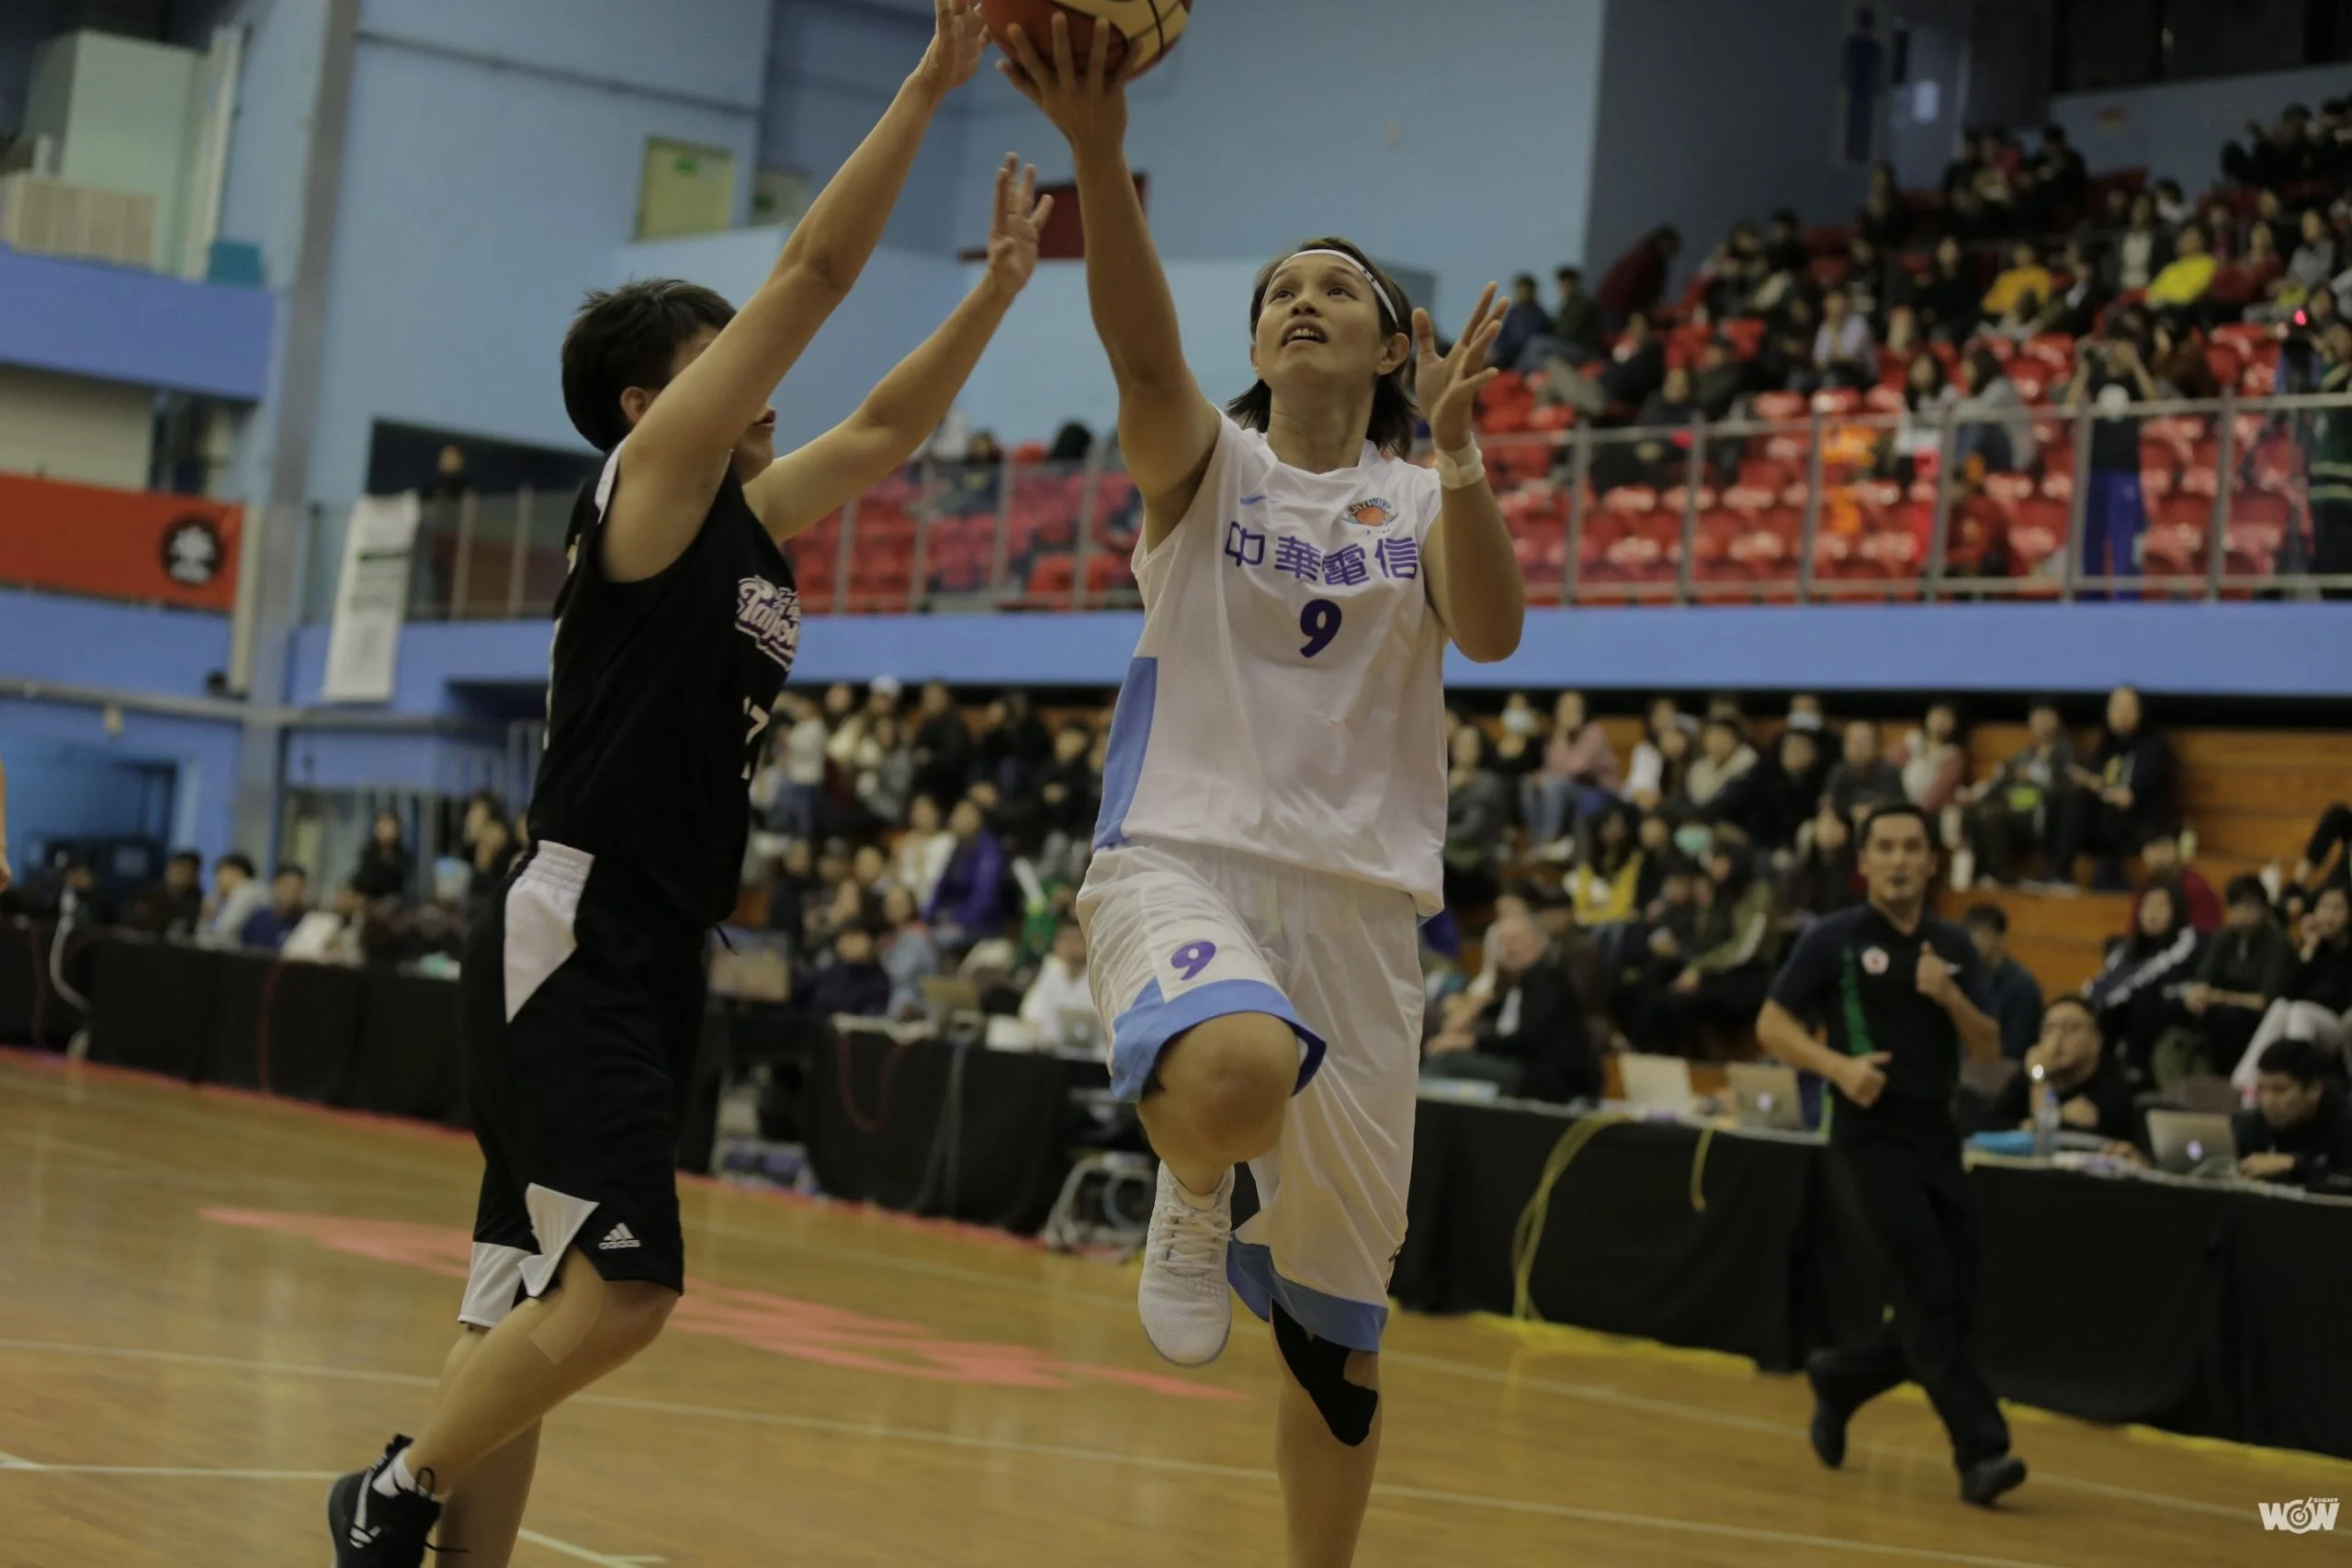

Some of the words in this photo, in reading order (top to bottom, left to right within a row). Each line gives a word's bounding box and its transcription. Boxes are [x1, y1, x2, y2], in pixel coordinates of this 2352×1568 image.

[1225, 521, 1418, 586] 中華電信
[1299, 599, 1342, 659] 9
[1170, 941, 1216, 981] 9
